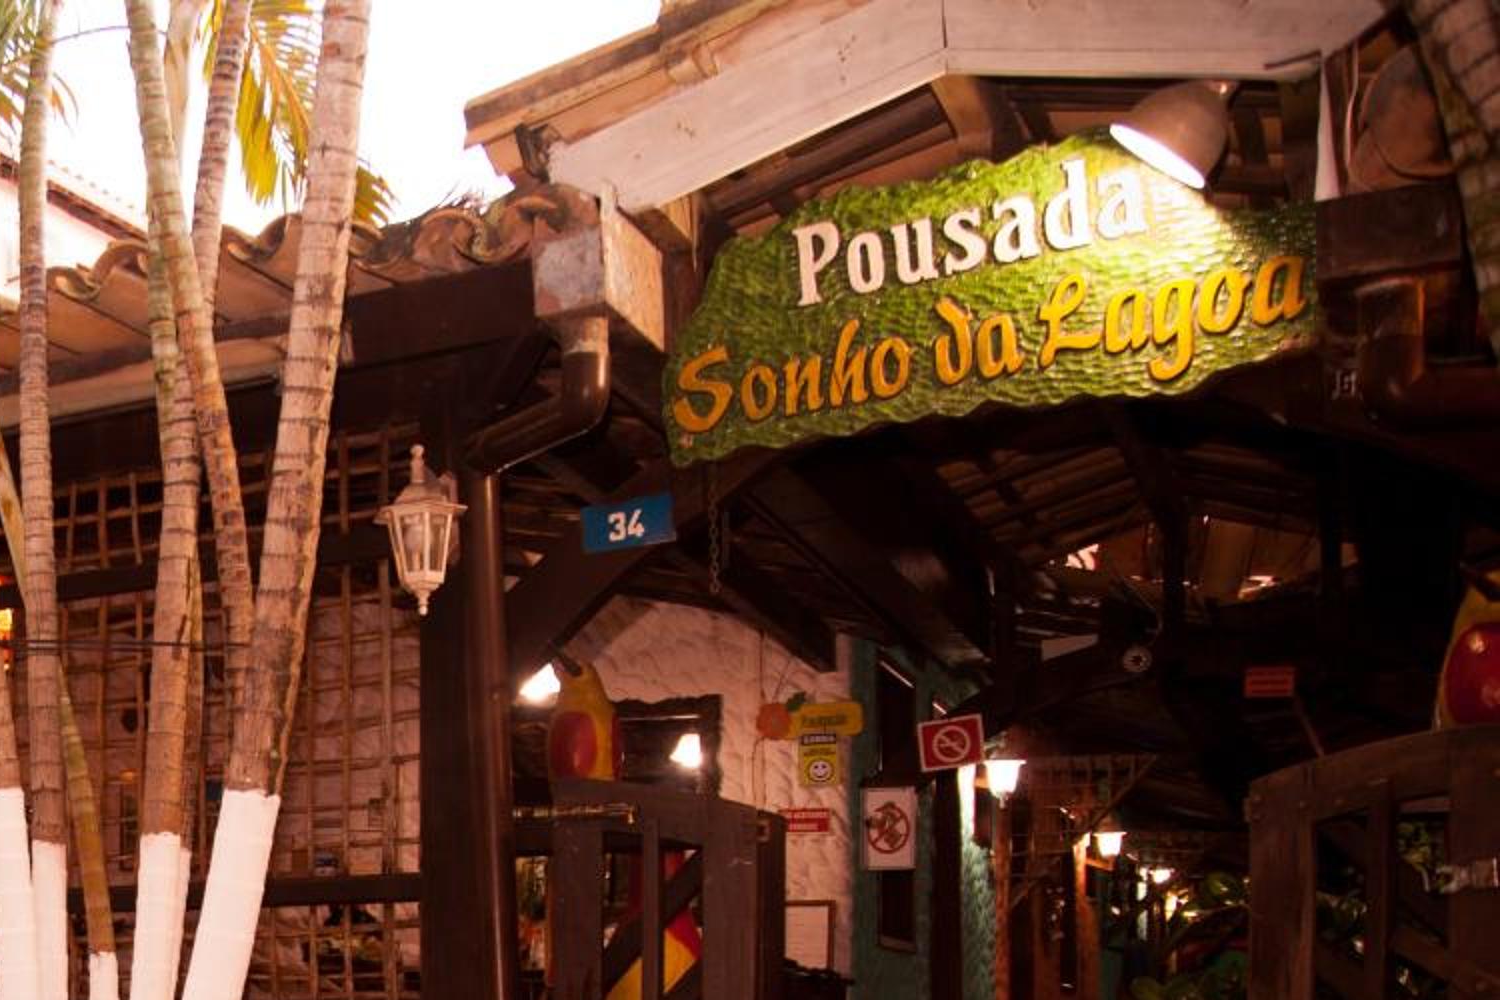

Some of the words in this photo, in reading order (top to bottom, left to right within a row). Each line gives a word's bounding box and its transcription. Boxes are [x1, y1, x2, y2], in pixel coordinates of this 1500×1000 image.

[792, 158, 1149, 306] Pousada
[671, 319, 914, 434] Sonho
[934, 299, 1026, 386] da
[1038, 254, 1307, 382] Lagoa
[607, 508, 645, 542] 34
